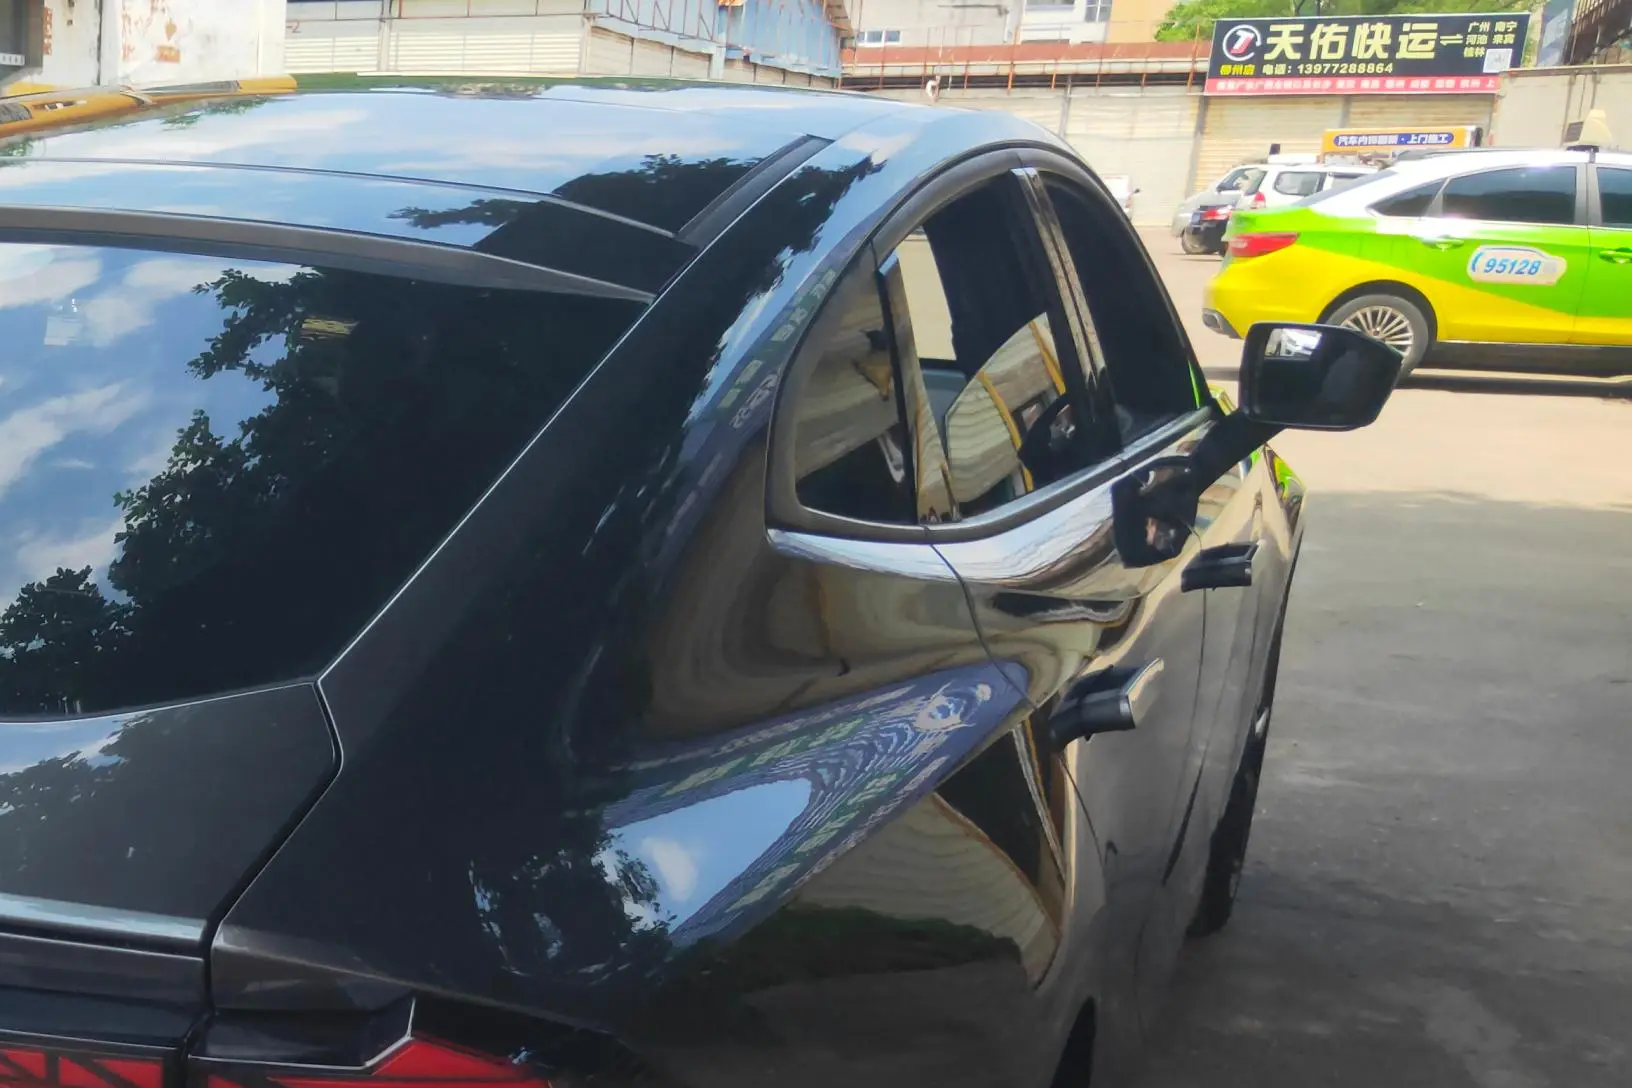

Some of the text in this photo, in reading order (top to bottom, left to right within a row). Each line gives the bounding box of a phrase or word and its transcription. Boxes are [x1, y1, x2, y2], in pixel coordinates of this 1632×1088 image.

[1469, 21, 1517, 33] 广州 南宁
[1264, 22, 1439, 61] 天佑快运
[1465, 34, 1488, 46] 河池
[1483, 257, 1541, 275] 95128
